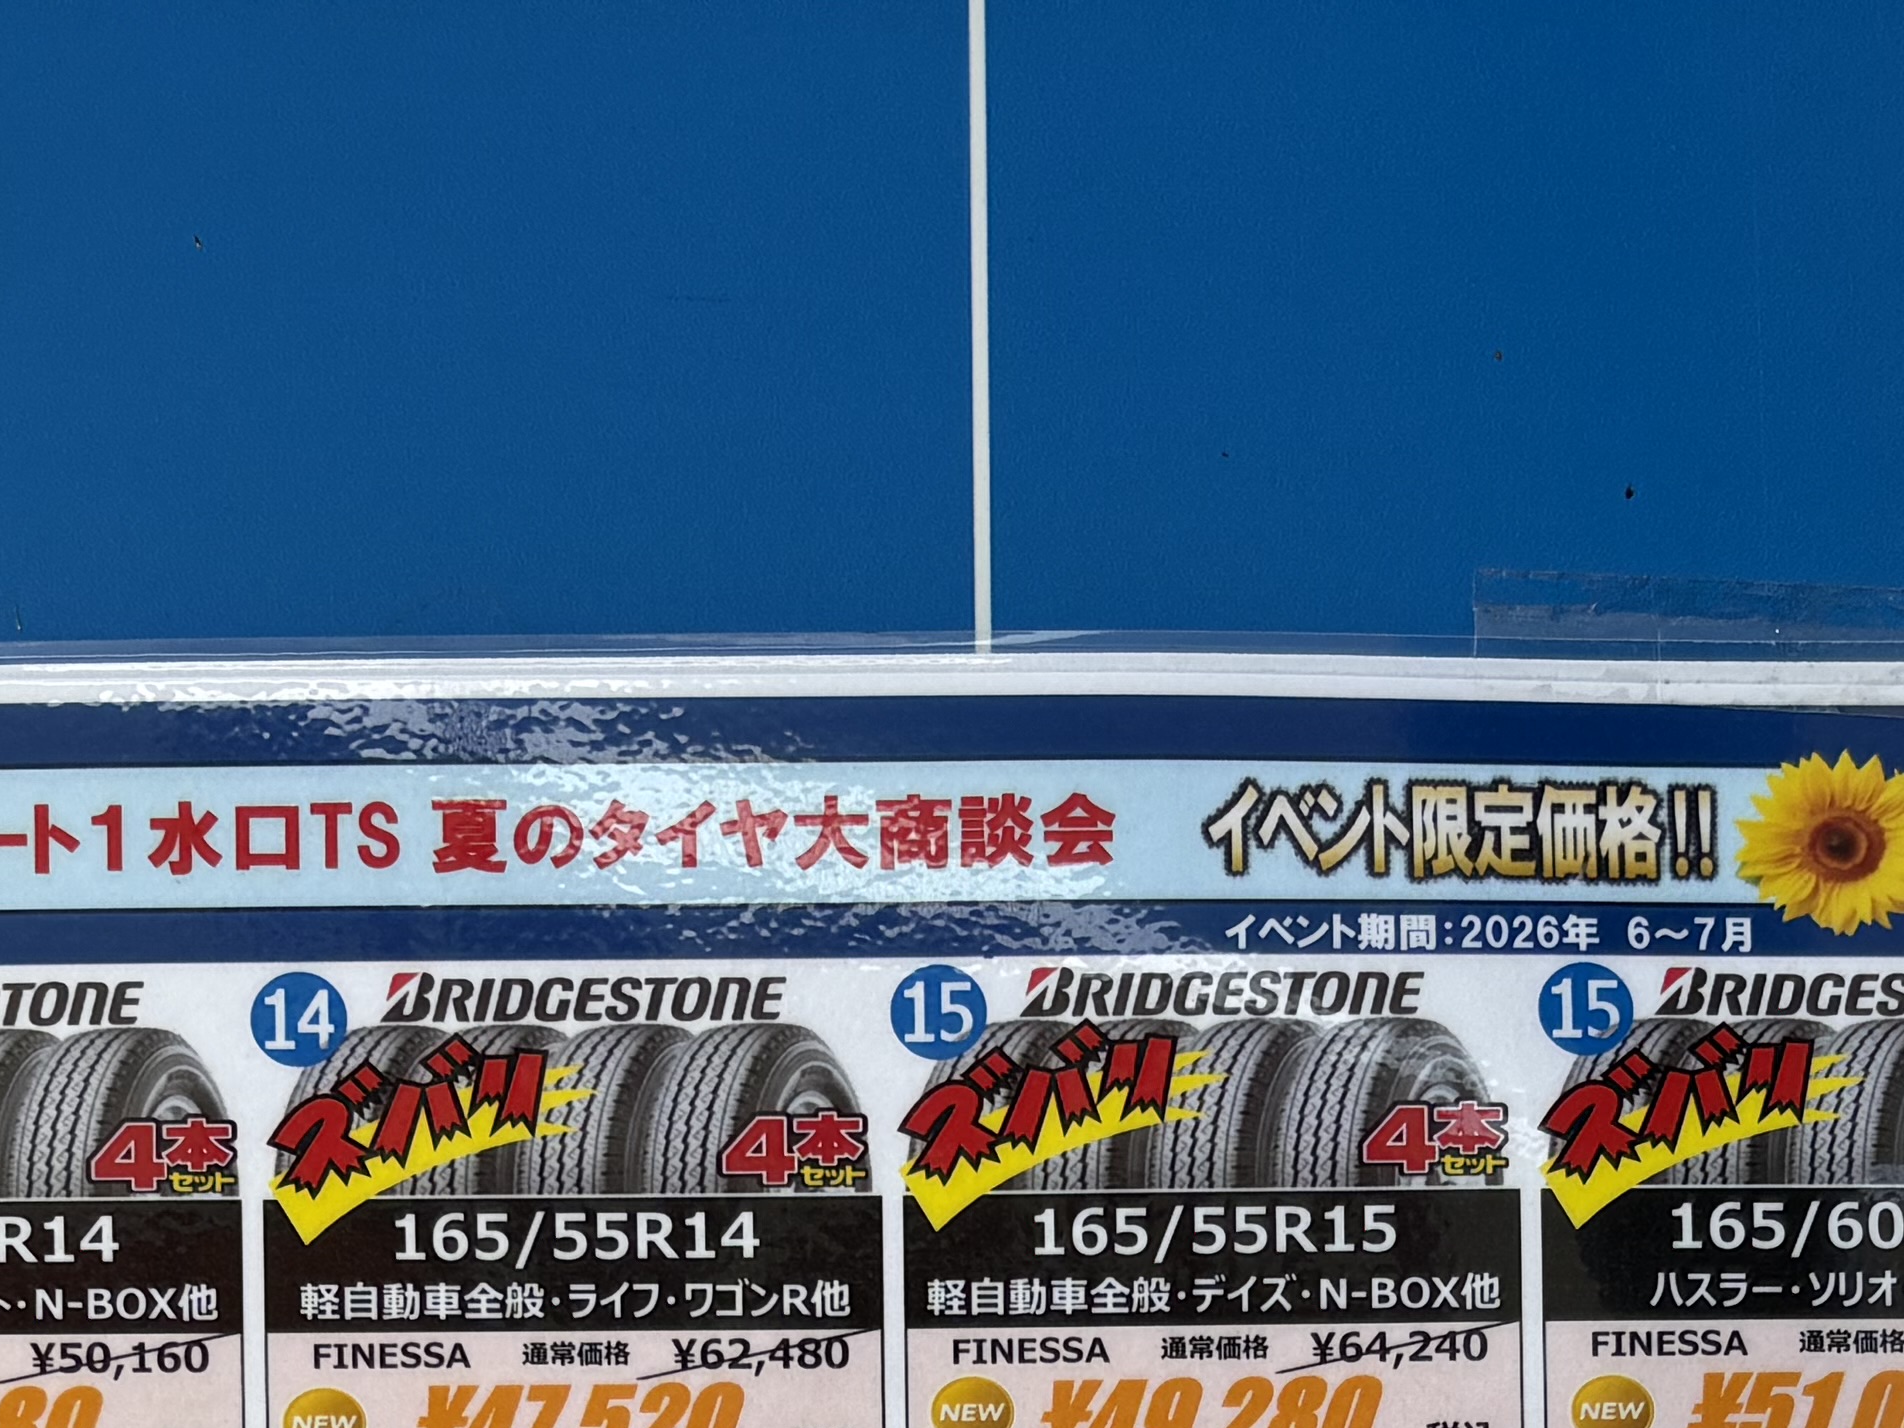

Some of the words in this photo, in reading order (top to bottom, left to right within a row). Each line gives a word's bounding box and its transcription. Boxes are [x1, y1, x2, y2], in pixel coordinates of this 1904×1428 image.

[431, 792, 1116, 873] 夏のタイヤ大商談会
[384, 972, 784, 1024] BRIDGESTONE
[1552, 978, 1619, 1038] 15
[395, 1211, 759, 1269] 165/55R14
[1035, 1205, 1396, 1263] 165/55R15
[1592, 1330, 1748, 1356] FINESSA
